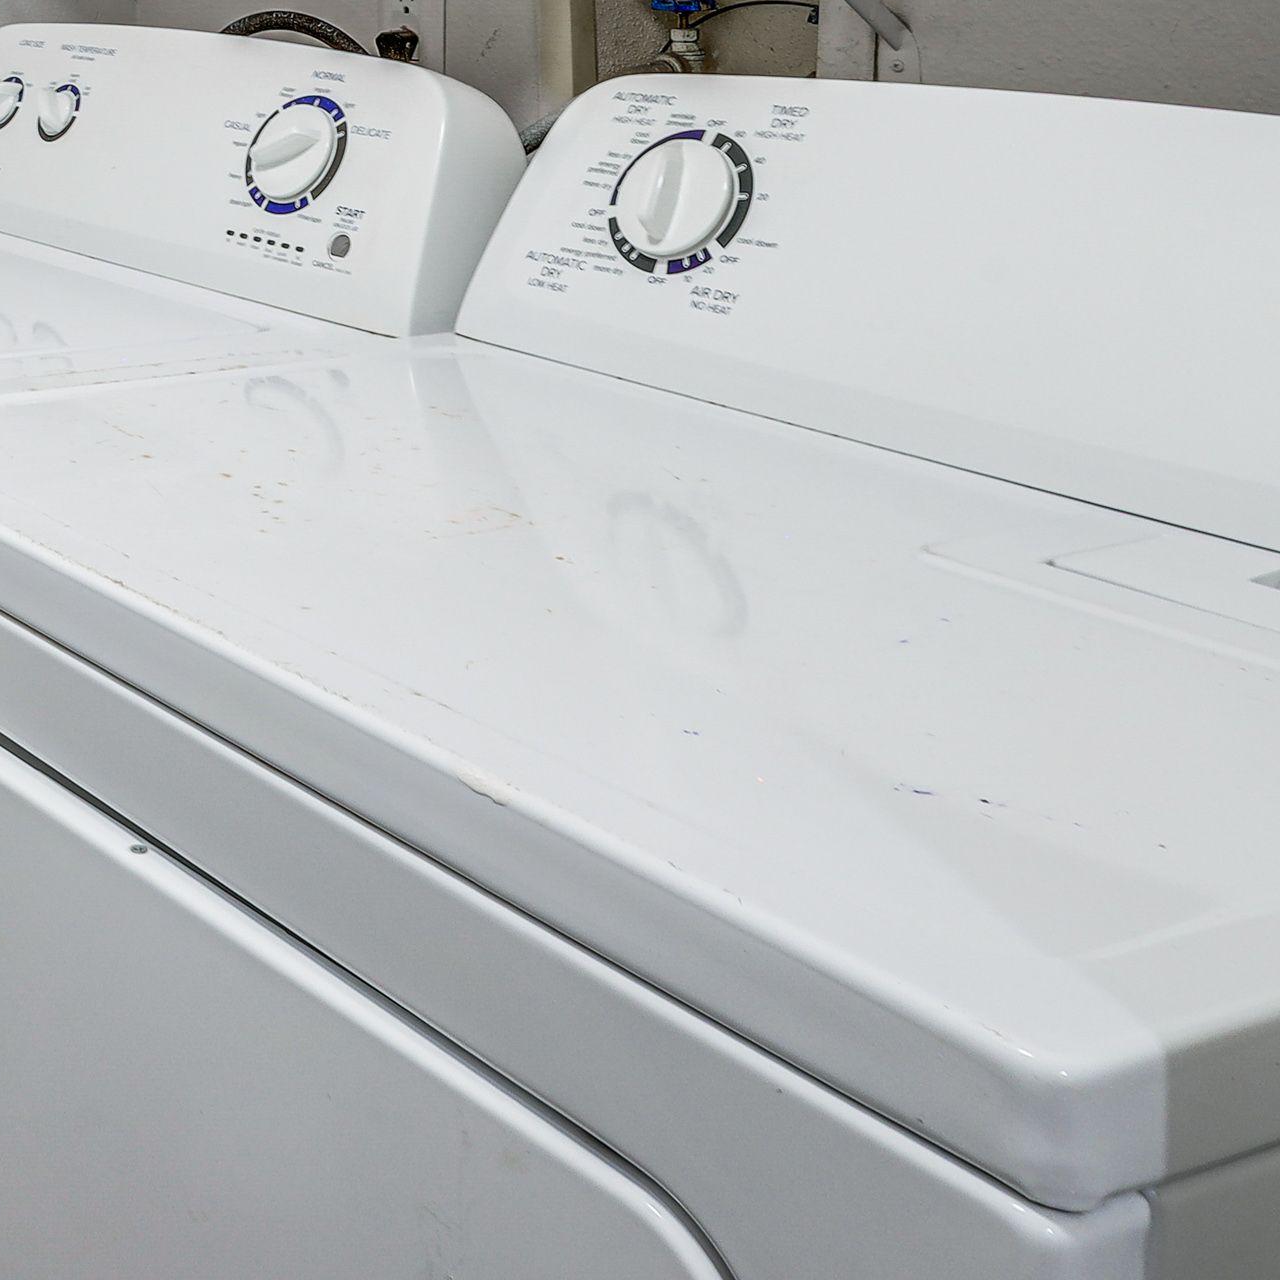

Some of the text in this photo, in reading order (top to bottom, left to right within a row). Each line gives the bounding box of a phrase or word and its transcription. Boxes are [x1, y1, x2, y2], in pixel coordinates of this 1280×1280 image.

[312, 70, 345, 82] NORMAL
[613, 91, 677, 106] AUTOMATIC
[627, 105, 650, 114] DRY
[771, 105, 809, 117] TIMED
[224, 120, 251, 132] CASUAL
[707, 119, 727, 127] OFF
[771, 118, 798, 128] DRY
[351, 125, 392, 140] DELICATE
[336, 205, 365, 219] START
[588, 208, 606, 217] OFF
[526, 250, 587, 271] AUTOMATIC
[720, 255, 740, 264] OFF
[540, 266, 563, 279] DRY
[647, 276, 668, 285] OFF
[690, 285, 740, 304] AIR DRY
[690, 300, 733, 316] NO HEAT
